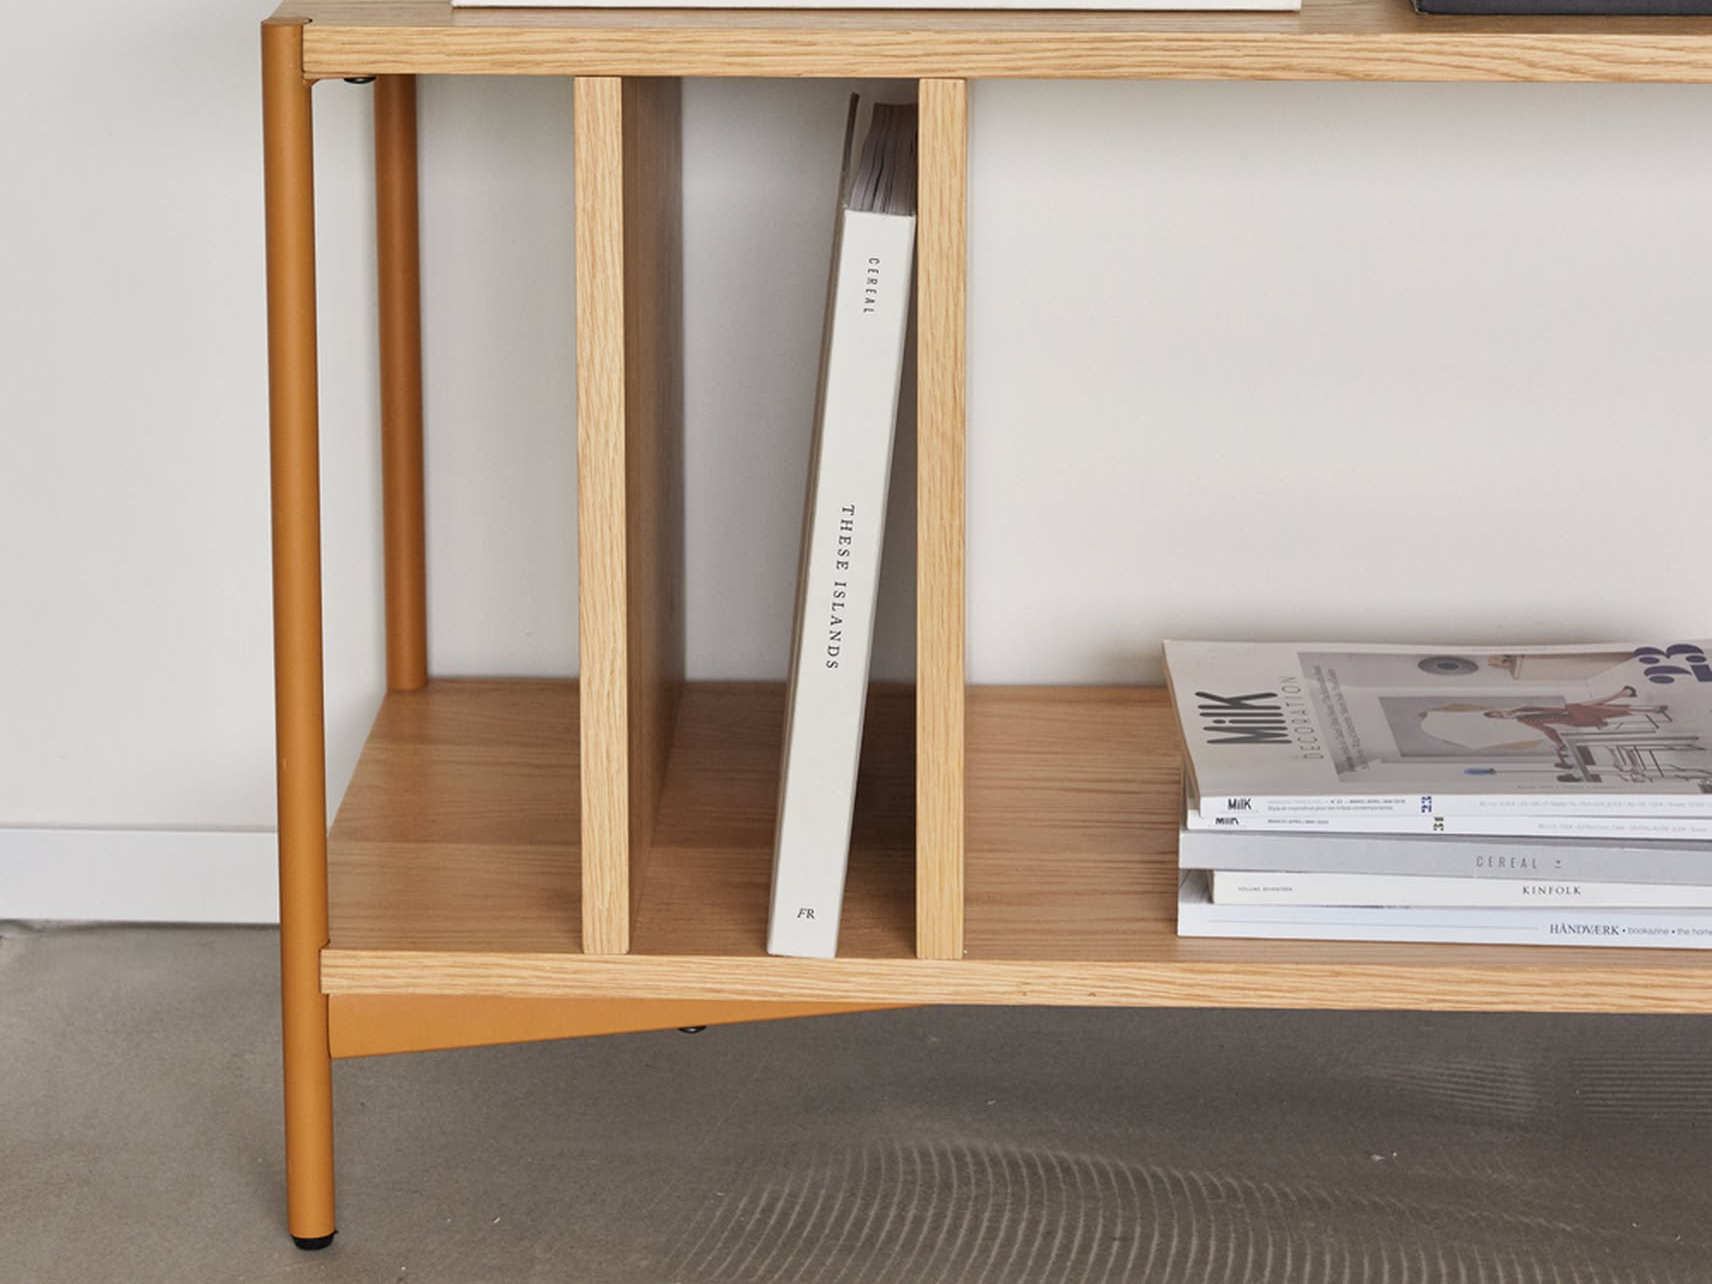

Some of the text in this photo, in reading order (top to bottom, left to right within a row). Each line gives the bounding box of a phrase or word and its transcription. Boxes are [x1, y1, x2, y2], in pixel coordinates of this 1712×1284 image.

[863, 257, 881, 314] CEREAL
[825, 504, 856, 670] THESE ISLANDS
[1280, 675, 1325, 760] DECORATION
[1476, 855, 1538, 869] CEREAL
[1522, 885, 1582, 896] KINFOLK
[797, 907, 815, 919] FR
[1549, 922, 1620, 937] HÅNDVÆRK
[1627, 926, 1670, 936] bookazine
